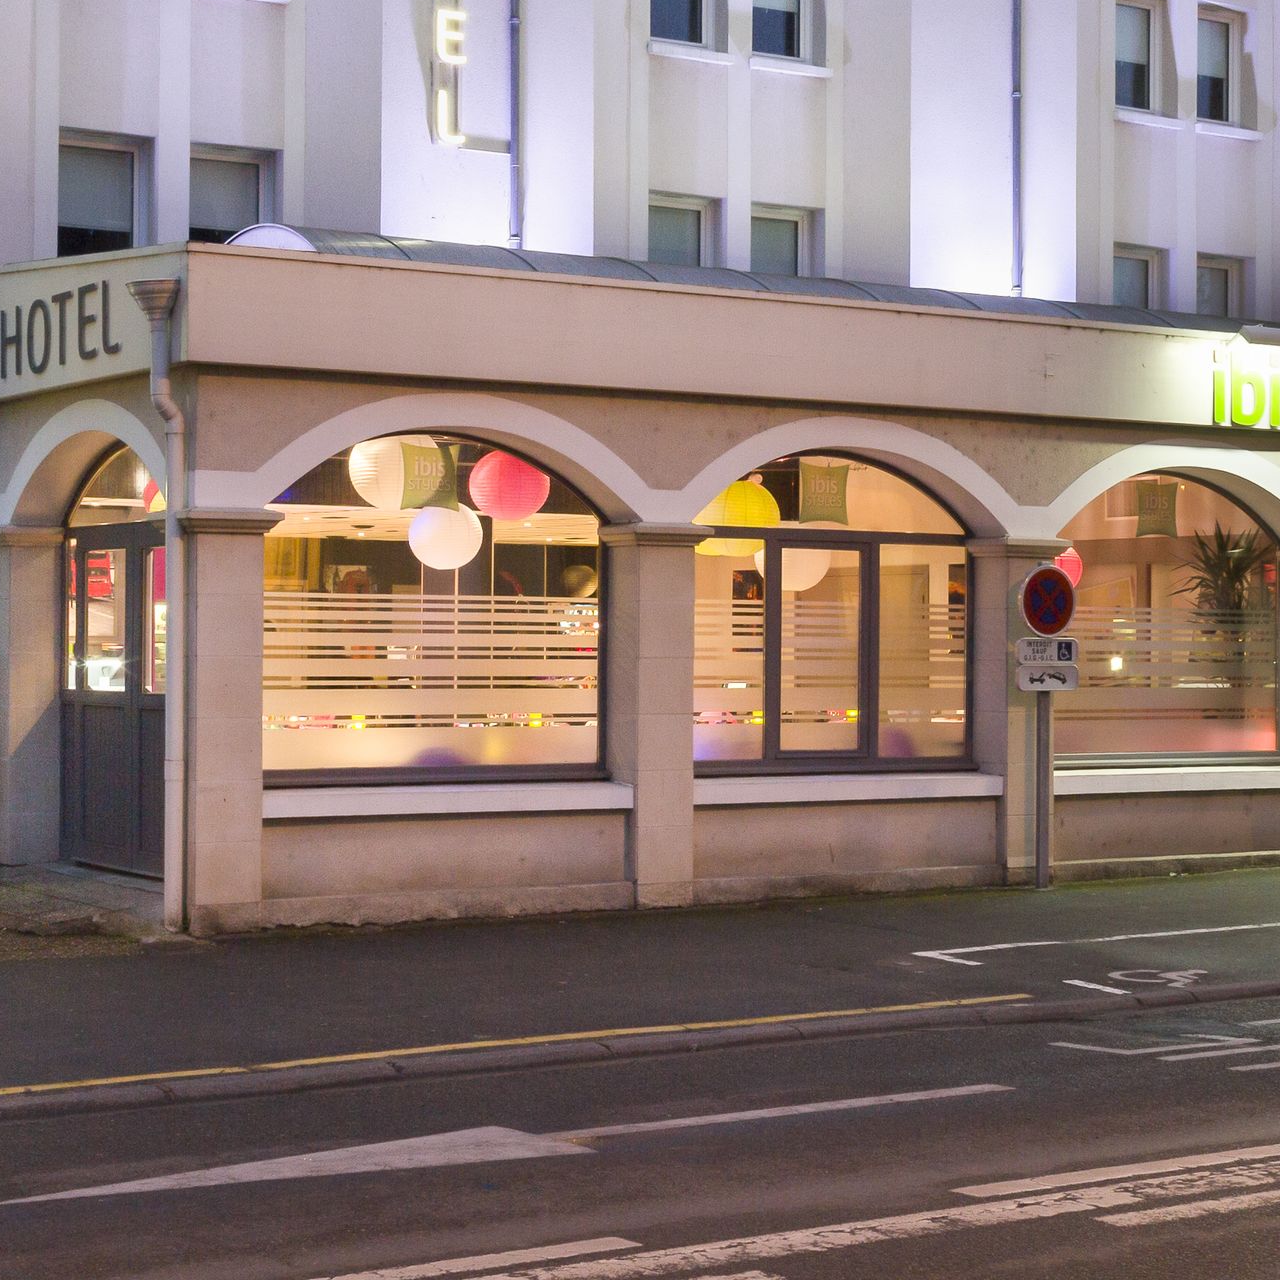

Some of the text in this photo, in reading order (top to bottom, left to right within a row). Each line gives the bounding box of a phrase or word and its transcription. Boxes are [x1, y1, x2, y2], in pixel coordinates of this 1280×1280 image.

[0, 279, 122, 380] HOTEL
[414, 455, 446, 477] ibis
[811, 474, 838, 494] ibis
